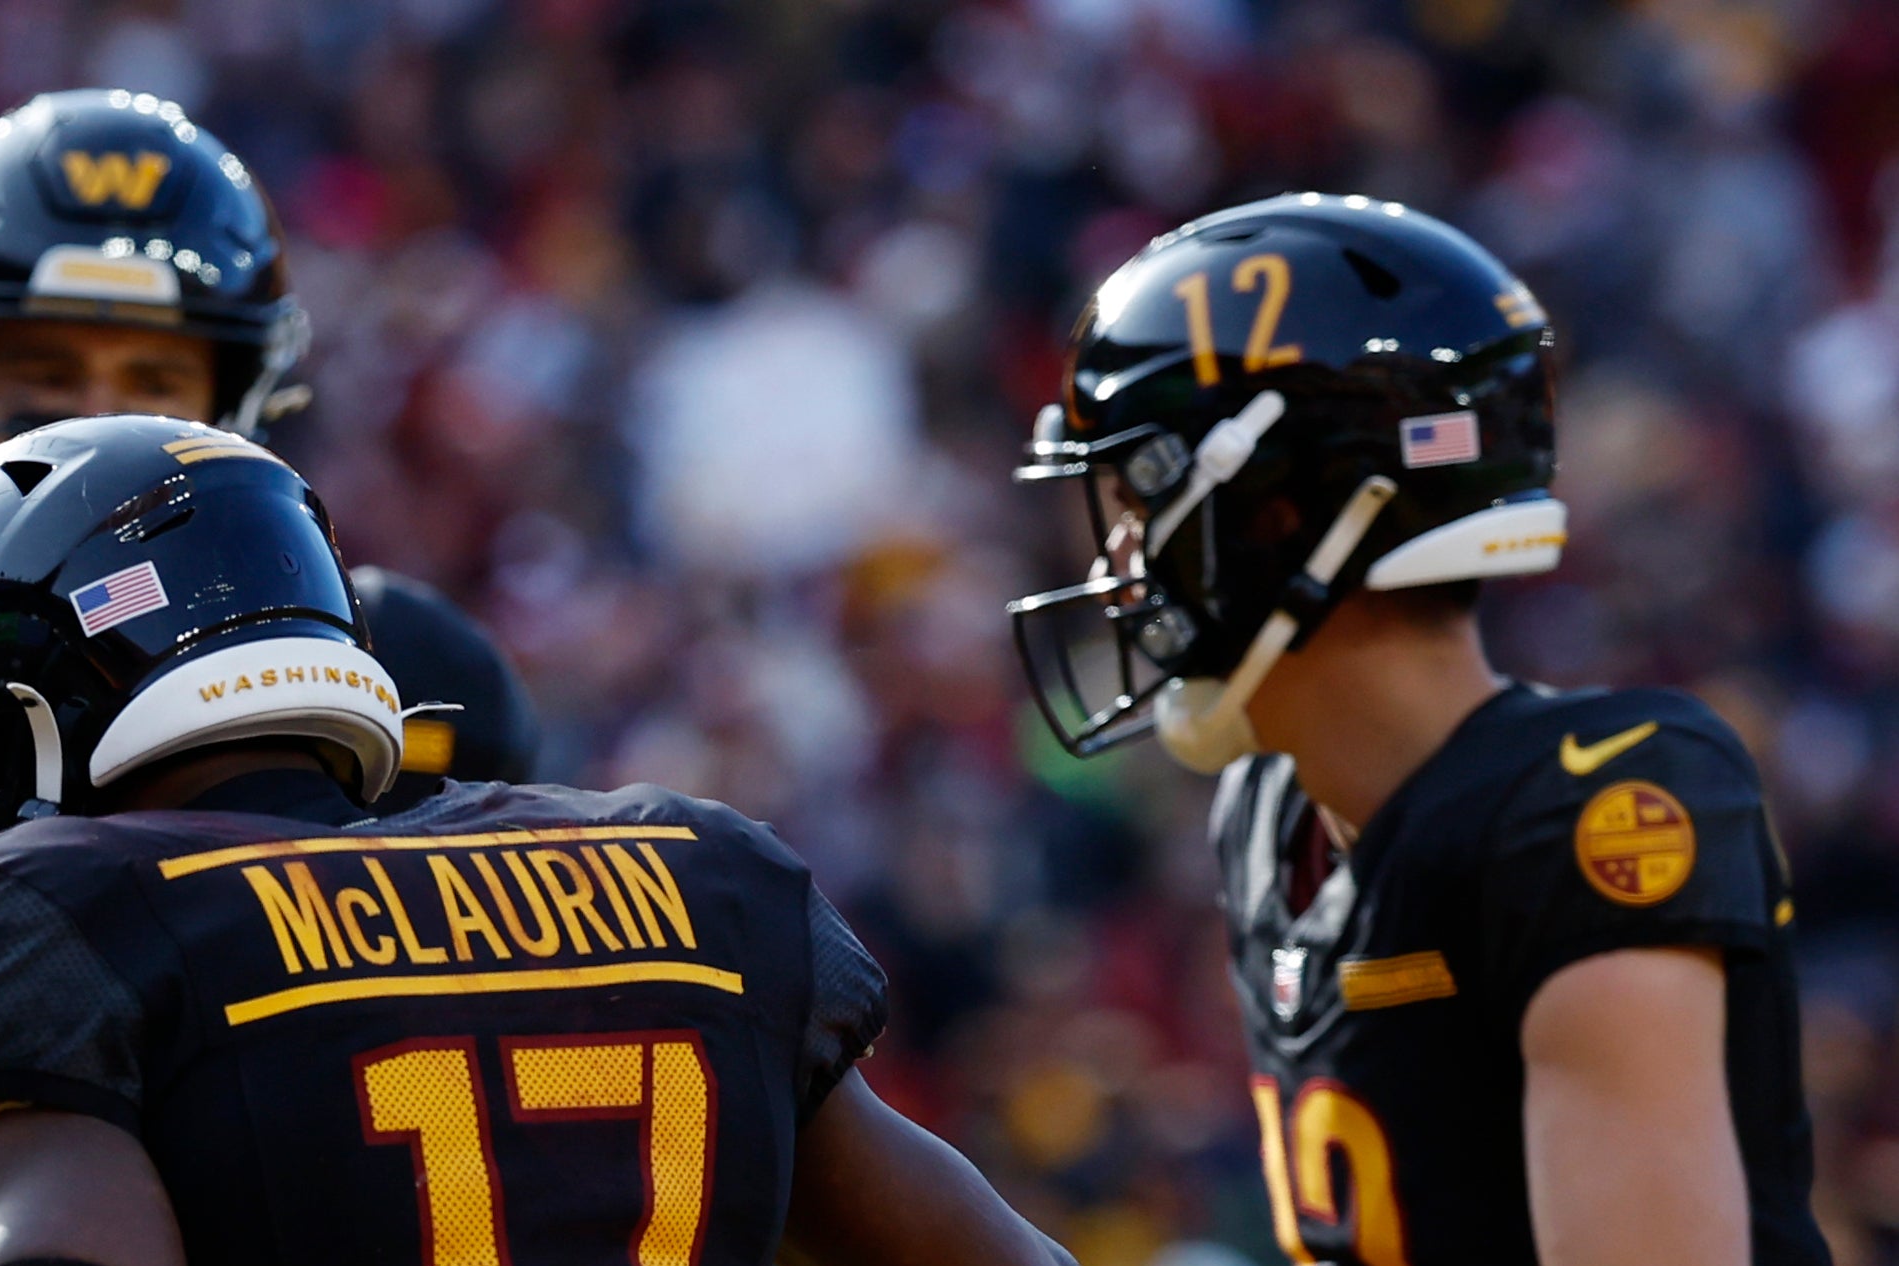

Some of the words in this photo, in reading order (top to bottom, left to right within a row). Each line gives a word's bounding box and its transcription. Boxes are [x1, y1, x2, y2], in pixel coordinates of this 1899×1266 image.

[61, 152, 172, 210] W
[1174, 253, 1304, 388] 12
[241, 843, 697, 974] McLAURIN
